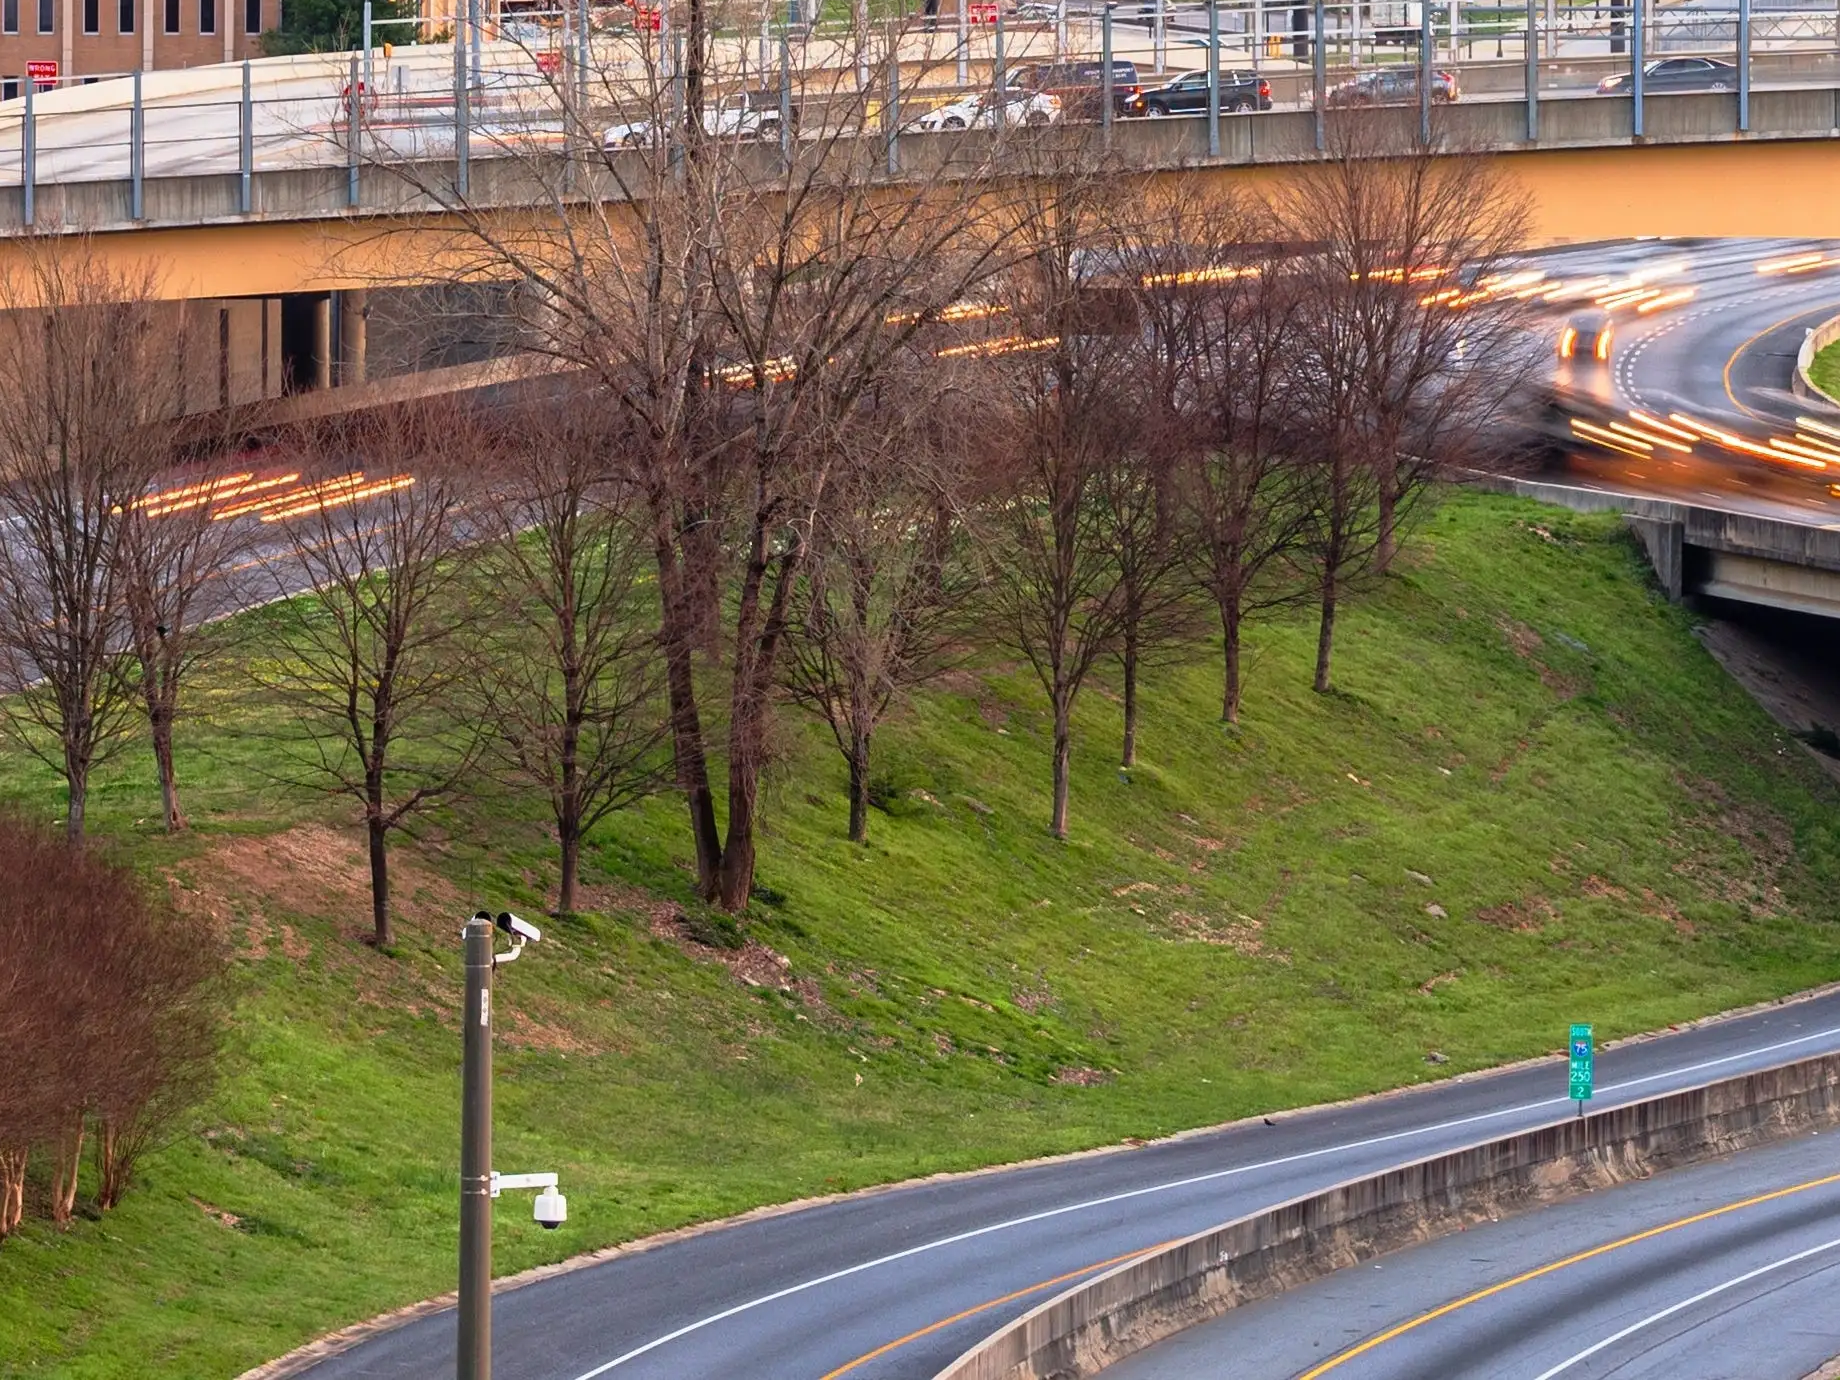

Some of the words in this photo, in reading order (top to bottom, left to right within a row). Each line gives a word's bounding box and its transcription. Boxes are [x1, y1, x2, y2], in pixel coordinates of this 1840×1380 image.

[28, 64, 56, 72] WRONG
[1572, 1027, 1592, 1037] SOUTH
[1575, 1043, 1588, 1054] 75
[1571, 1061, 1590, 1070] MILE
[1571, 1071, 1591, 1082] 250
